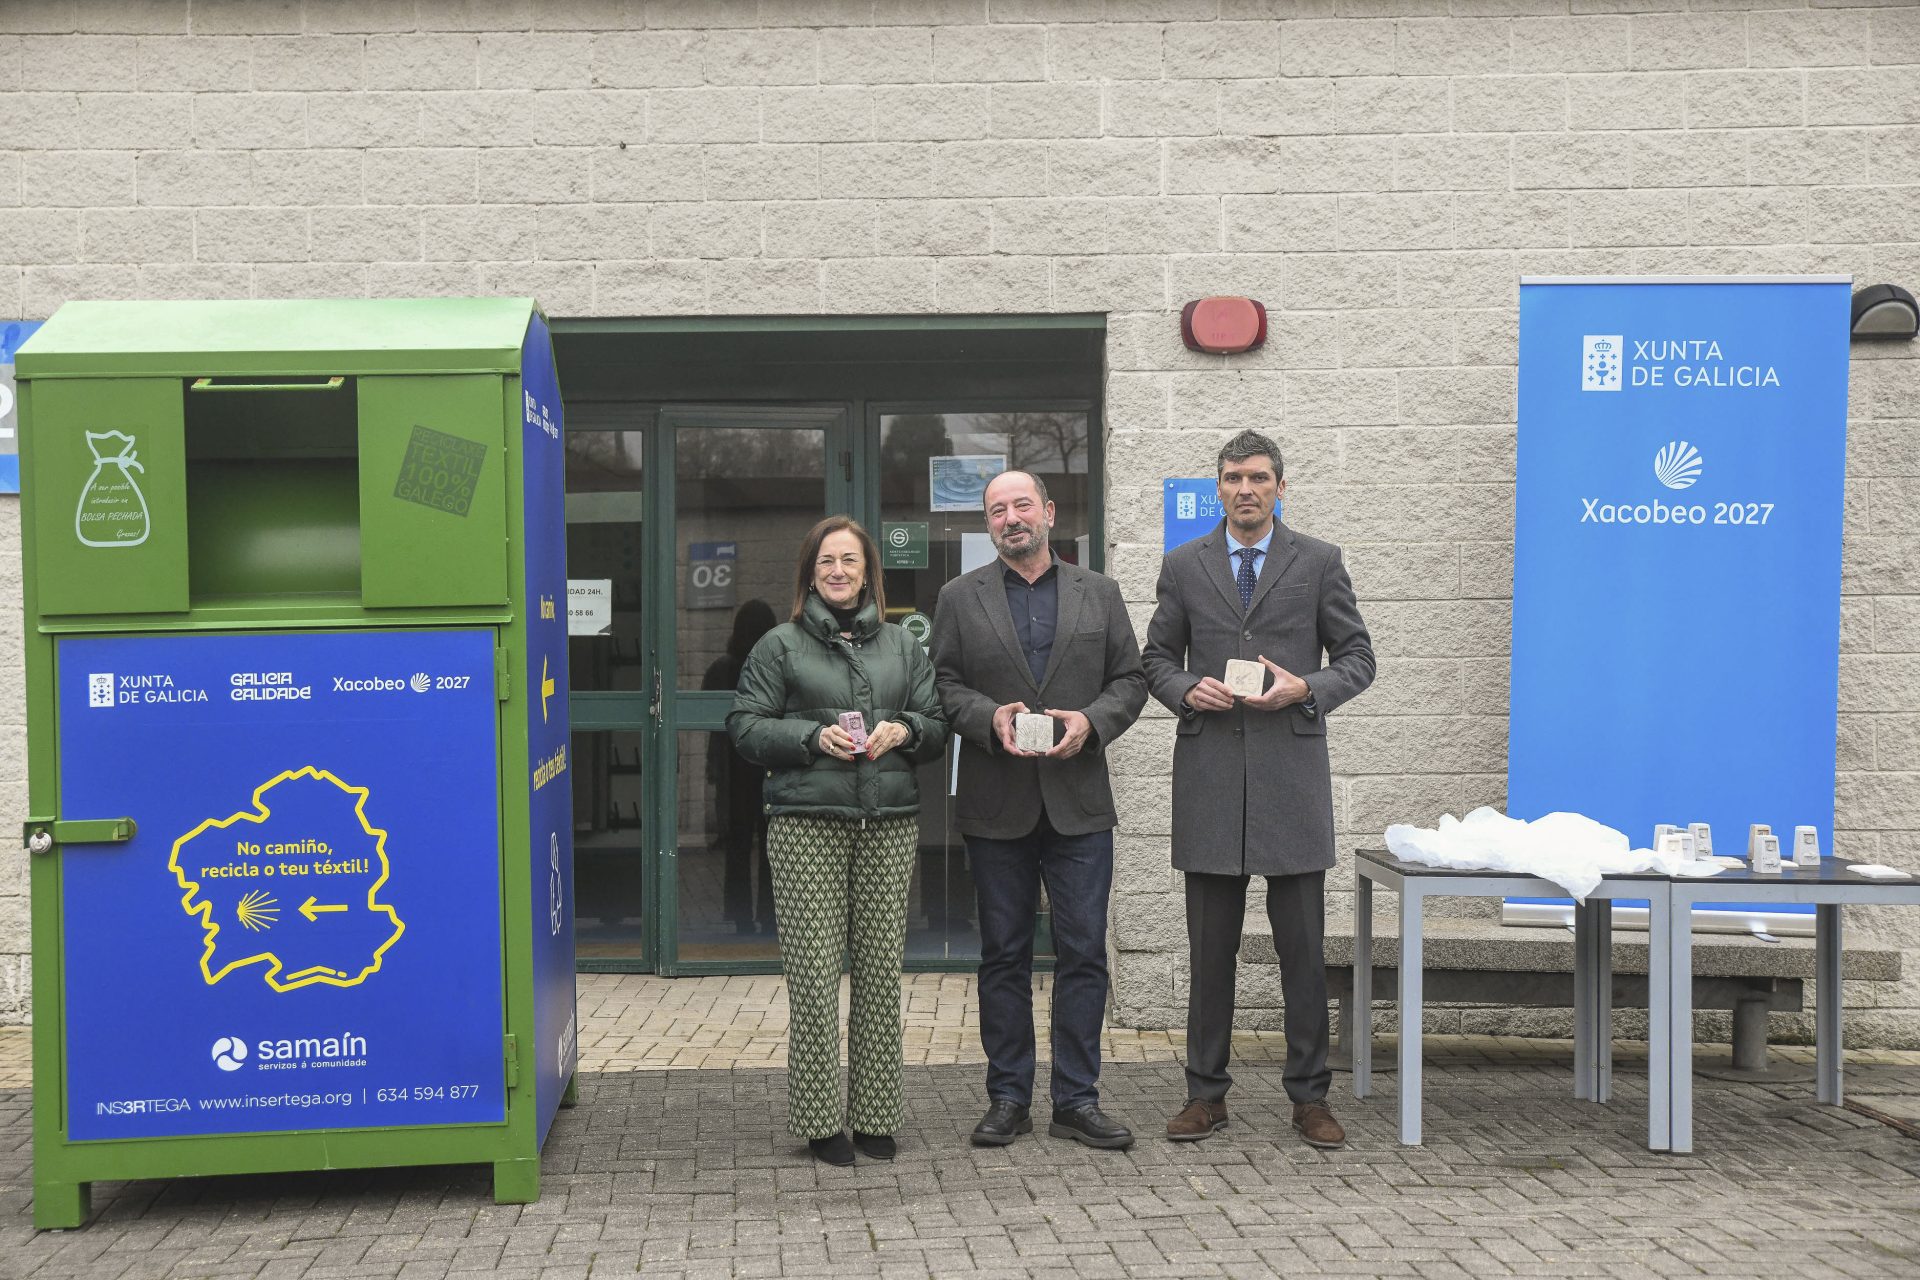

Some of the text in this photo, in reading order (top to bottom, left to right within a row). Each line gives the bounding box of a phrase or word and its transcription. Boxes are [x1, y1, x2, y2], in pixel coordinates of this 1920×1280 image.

[1633, 340, 1724, 361] XUNTA
[1631, 366, 1781, 387] DE GALICIA
[411, 441, 478, 477] TEXTIL
[406, 462, 471, 498] 100%
[399, 480, 468, 514] GALEGO
[81, 511, 143, 522] BOLSA PECHADA
[1200, 506, 1215, 517] DE
[1580, 498, 1775, 525] Xacobeo 2027
[119, 675, 174, 688] XUNTA
[230, 672, 293, 686] GALICIA
[332, 676, 471, 692] Xacobeo 2027
[119, 689, 209, 704] DE GALICIA
[230, 685, 312, 701] CALIDADE
[237, 838, 333, 856] No camiño,
[201, 858, 369, 878] recicla o teu téxtil!
[258, 1031, 367, 1060] samaín
[258, 1061, 297, 1071] servizos
[311, 1058, 367, 1068] comunidade
[96, 1084, 479, 1115] INS3RTEGA www.insertega.org 634 594 877
